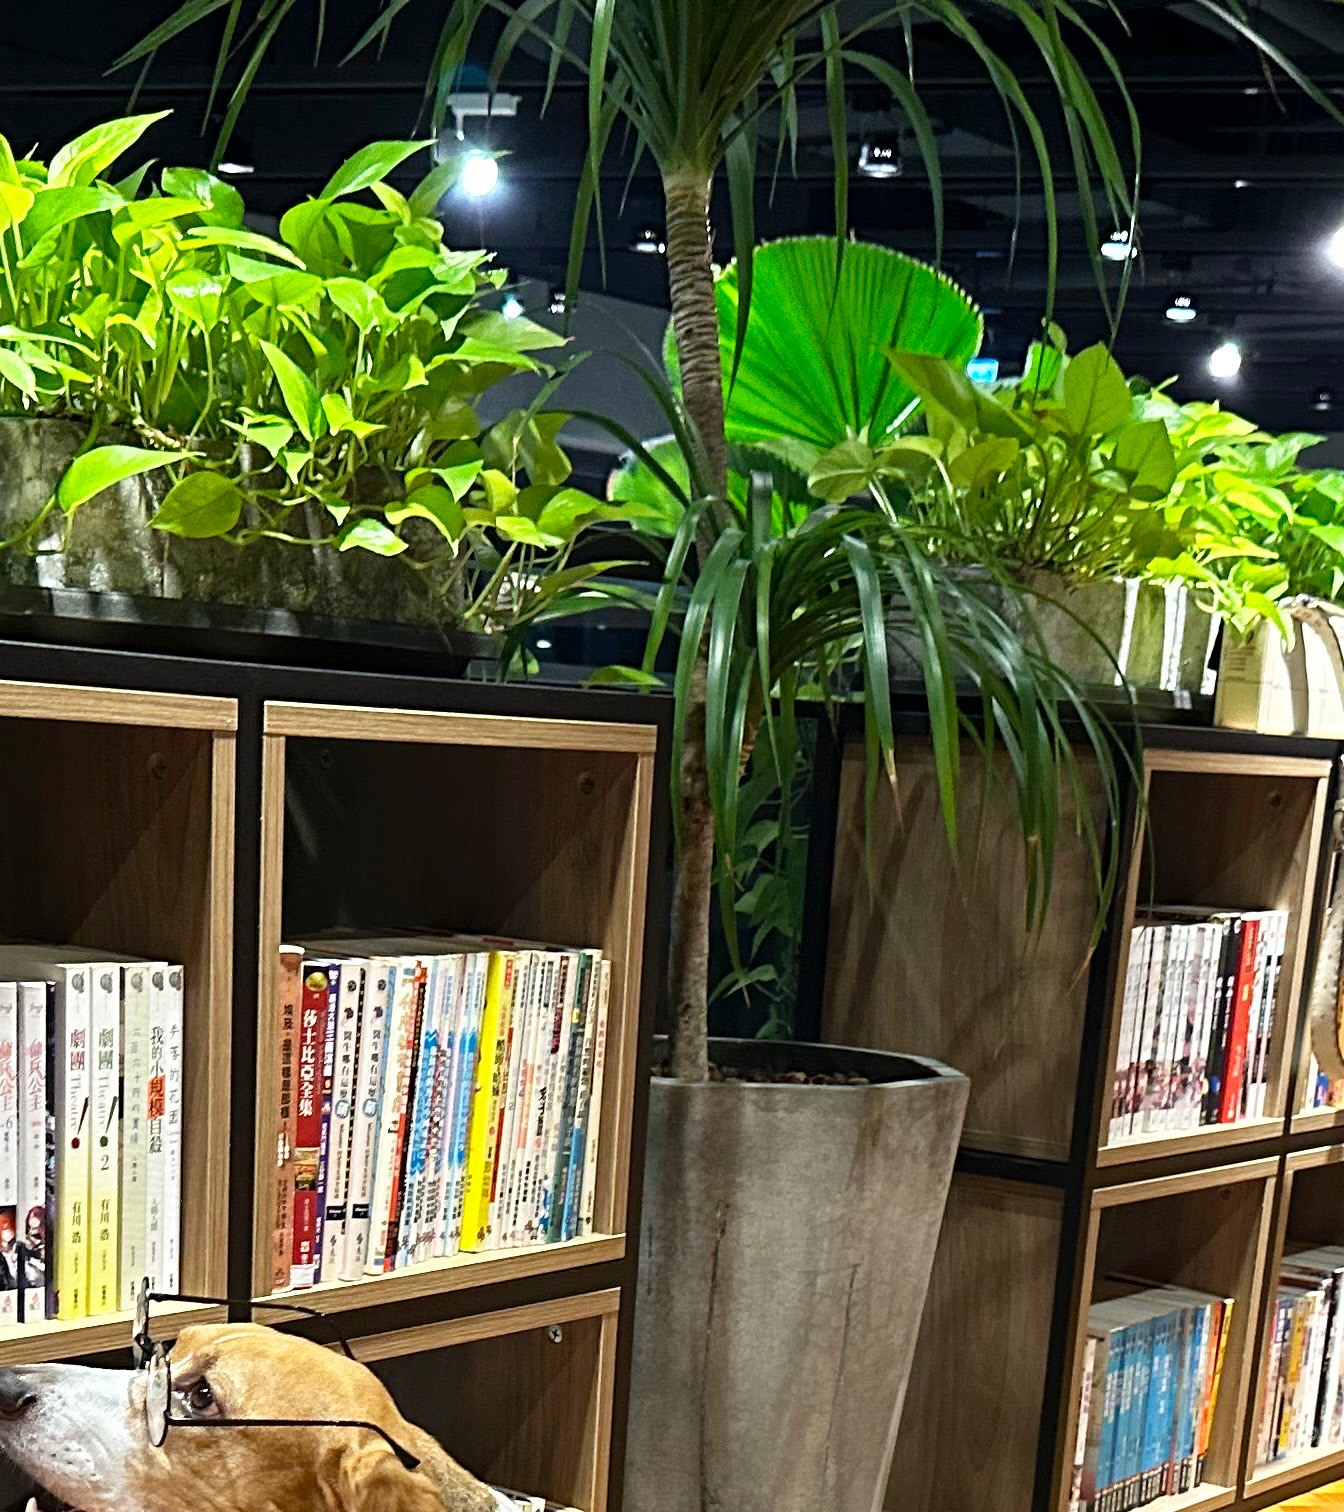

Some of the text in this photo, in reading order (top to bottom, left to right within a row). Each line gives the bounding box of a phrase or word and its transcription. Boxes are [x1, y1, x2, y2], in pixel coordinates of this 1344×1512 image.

[70, 1028, 86, 1071] 劇團
[99, 1028, 114, 1071] 劇團
[298, 1008, 317, 1117] 莎士比亞全集
[100, 1154, 110, 1171] 2
